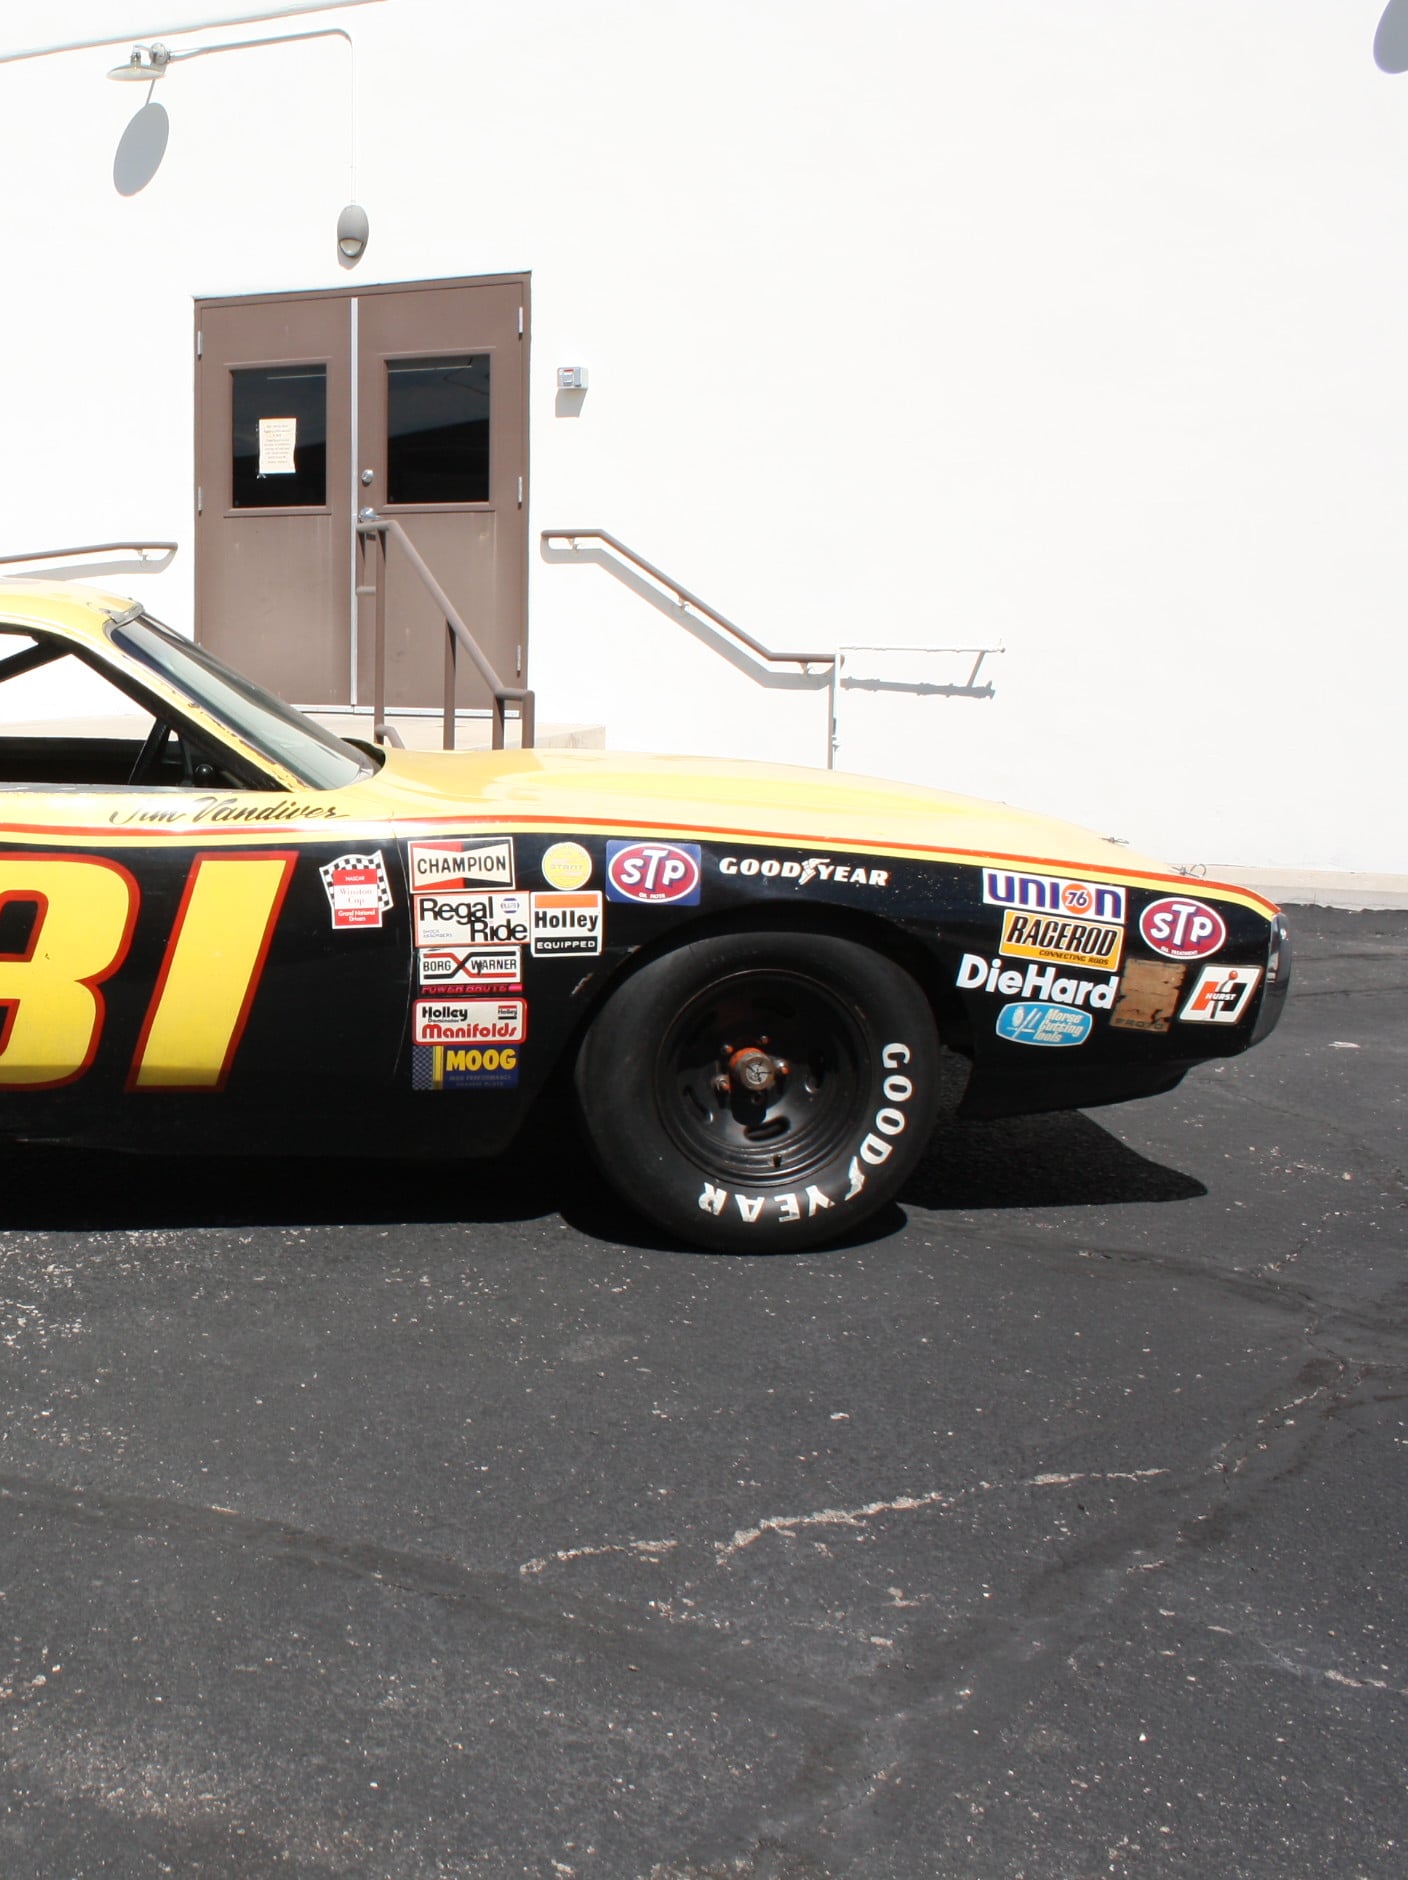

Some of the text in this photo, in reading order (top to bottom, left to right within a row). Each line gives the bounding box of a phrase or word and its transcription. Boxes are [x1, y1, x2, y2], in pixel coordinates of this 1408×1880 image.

[417, 855, 507, 874] CHAMPION
[620, 850, 686, 890] STP
[1065, 890, 1089, 908] 76
[419, 896, 494, 925] Regal
[470, 918, 528, 942] Ride
[535, 910, 599, 932] Holley
[1150, 904, 1213, 946] STP
[536, 940, 596, 949] EQUIPPED
[1005, 915, 1118, 957] RACEROD
[423, 959, 517, 972] BORG WARNER
[1038, 950, 1086, 962] CONNECTING
[955, 953, 1120, 1010] DieHard
[1204, 992, 1237, 1000] HURST
[422, 1006, 468, 1022] Holley
[422, 1023, 518, 1039] Manifolds
[446, 1049, 517, 1072] MOOG
